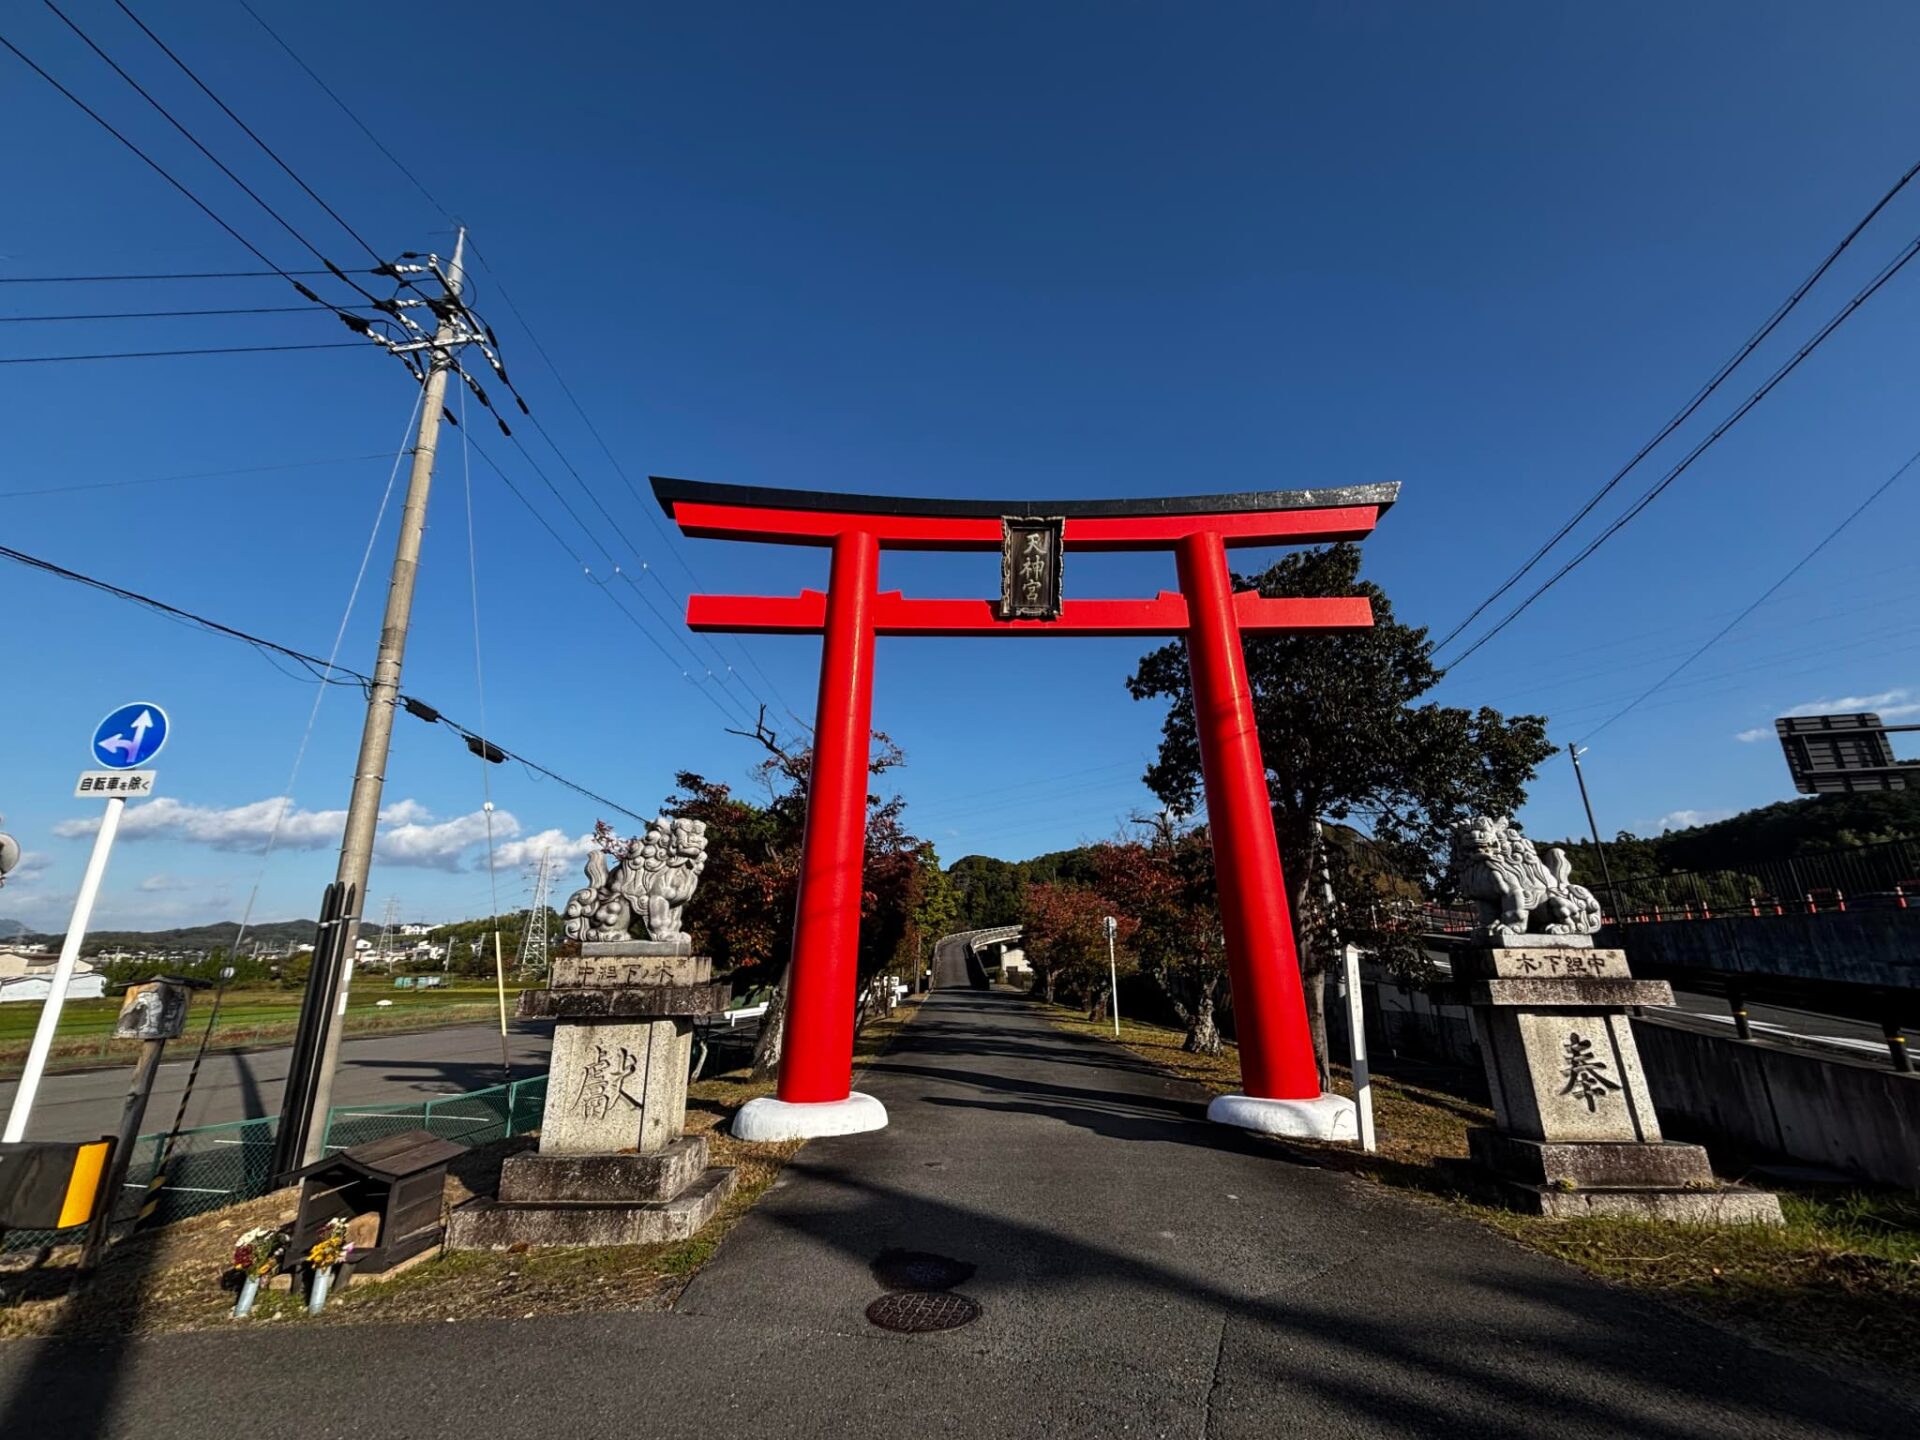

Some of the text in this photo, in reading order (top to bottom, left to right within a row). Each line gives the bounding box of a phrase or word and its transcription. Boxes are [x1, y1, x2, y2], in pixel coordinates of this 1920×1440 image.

[1019, 533, 1047, 603] 天神宮
[80, 776, 149, 791] 自転車を除く
[1558, 1032, 1623, 1113] 奉
